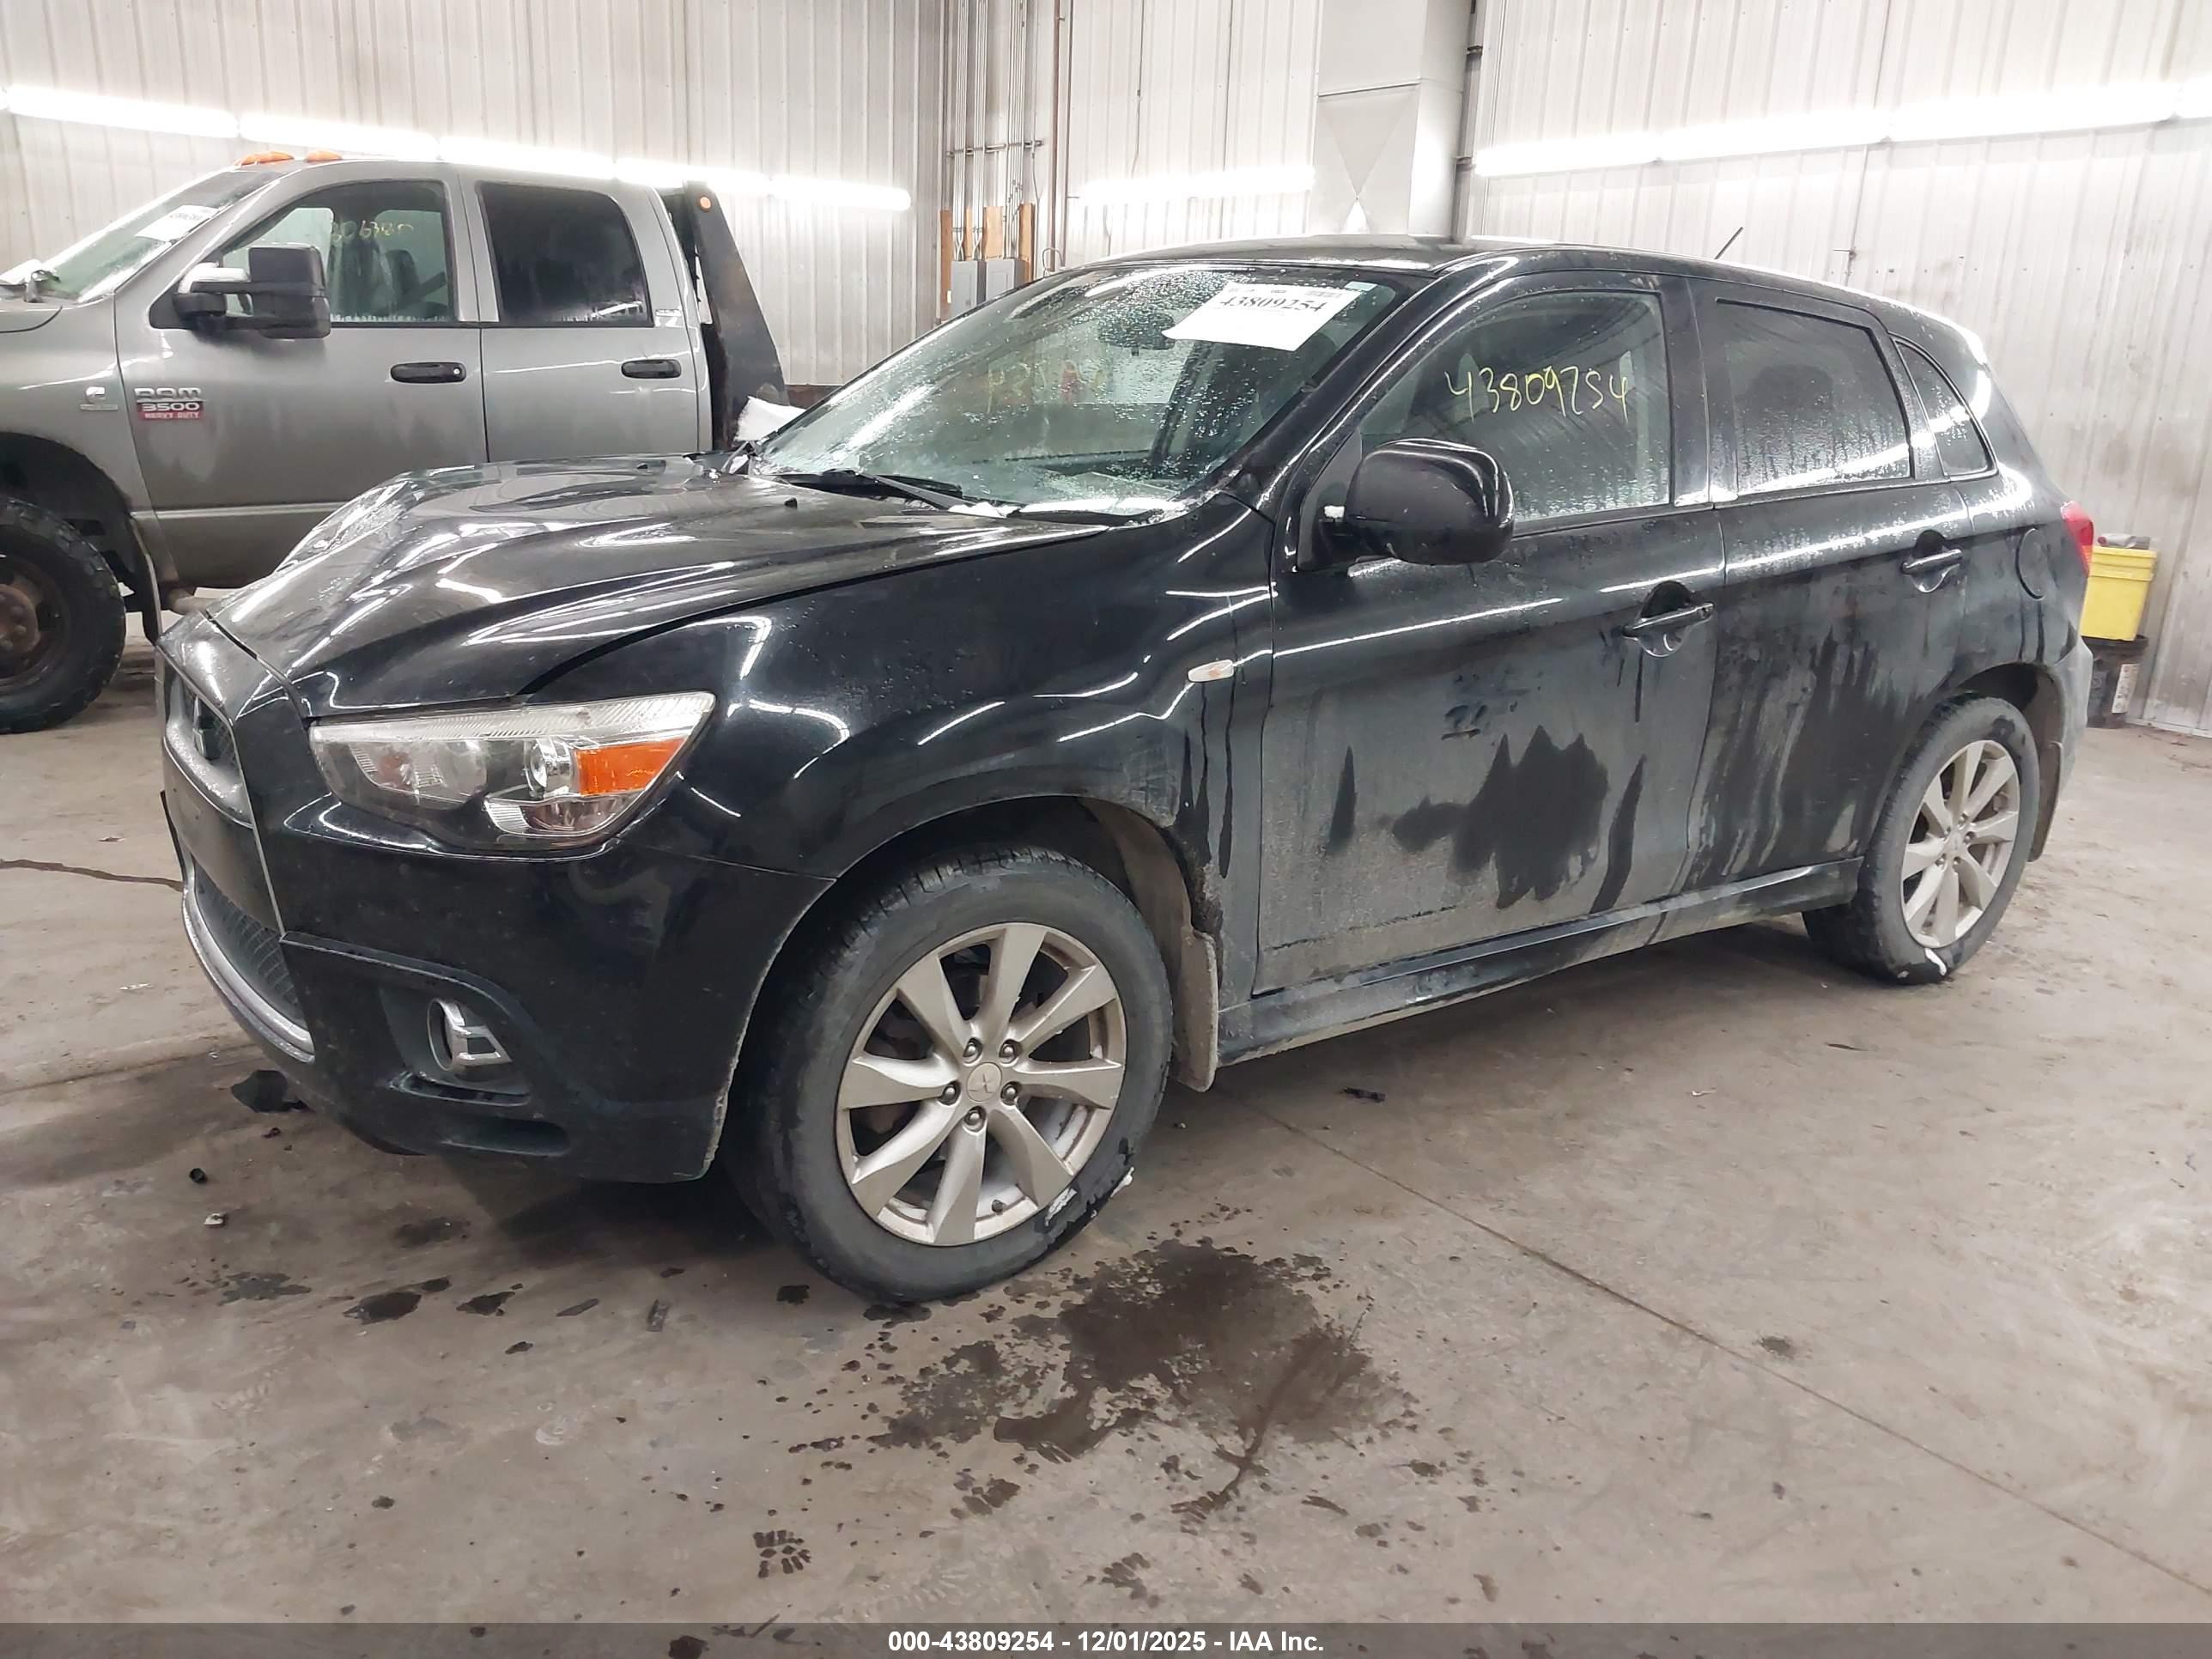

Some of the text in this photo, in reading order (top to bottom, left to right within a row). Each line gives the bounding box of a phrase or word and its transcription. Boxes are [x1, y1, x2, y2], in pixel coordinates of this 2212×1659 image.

[1220, 296, 1328, 312] 43809254
[134, 387, 204, 401] RAM
[1443, 365, 1629, 426] 43809254
[141, 402, 200, 412] 3500
